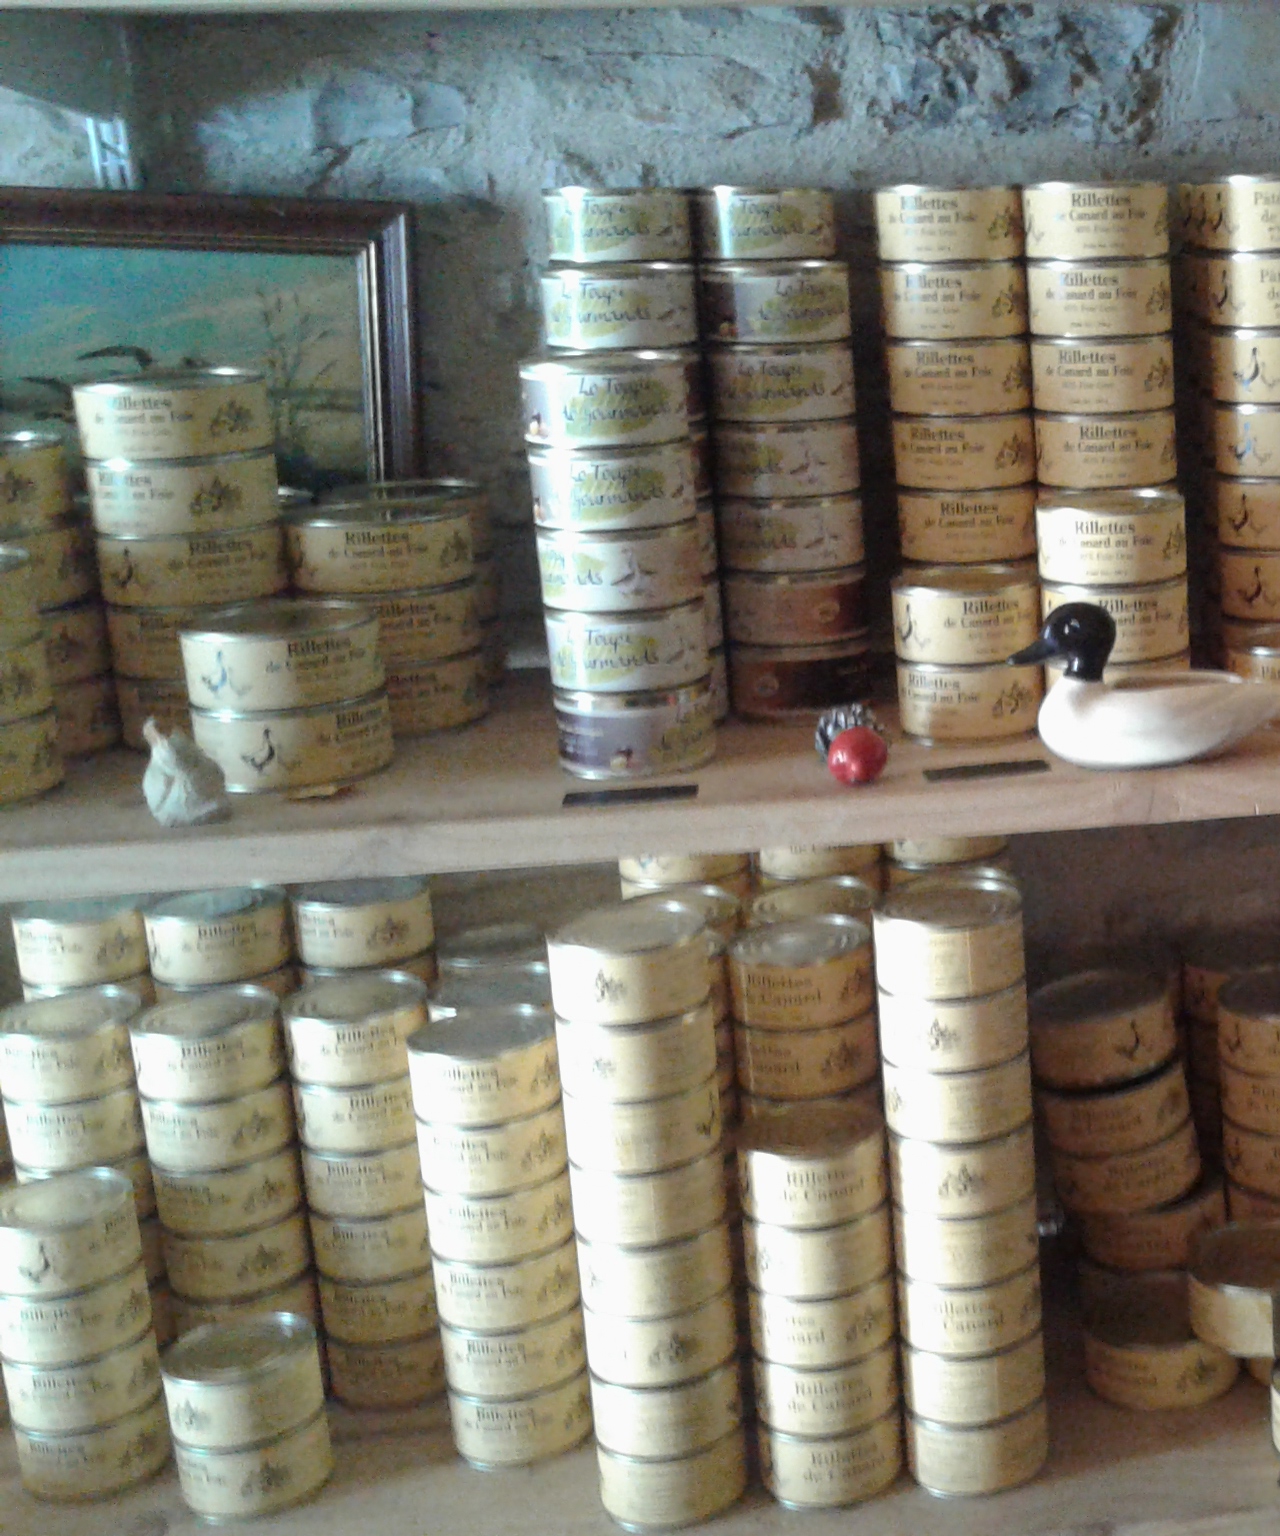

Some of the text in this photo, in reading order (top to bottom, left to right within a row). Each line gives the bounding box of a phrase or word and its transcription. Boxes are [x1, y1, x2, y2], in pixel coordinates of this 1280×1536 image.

[1071, 193, 1131, 207] Rillettes
[1069, 209, 1107, 222] Canard
[916, 351, 974, 365] Rillettes
[1058, 350, 1117, 364] Rillettes
[1057, 365, 1093, 378] Canard
[910, 427, 965, 441] Rillettes
[1080, 425, 1138, 440] Rillettes
[1077, 440, 1115, 453] Canard
[940, 502, 999, 515] Rillettes
[1075, 521, 1136, 535] Rillettes
[1115, 538, 1128, 547] au
[963, 600, 1019, 614] Rillettes
[961, 615, 997, 628] Canard
[908, 673, 960, 688] Rillettes
